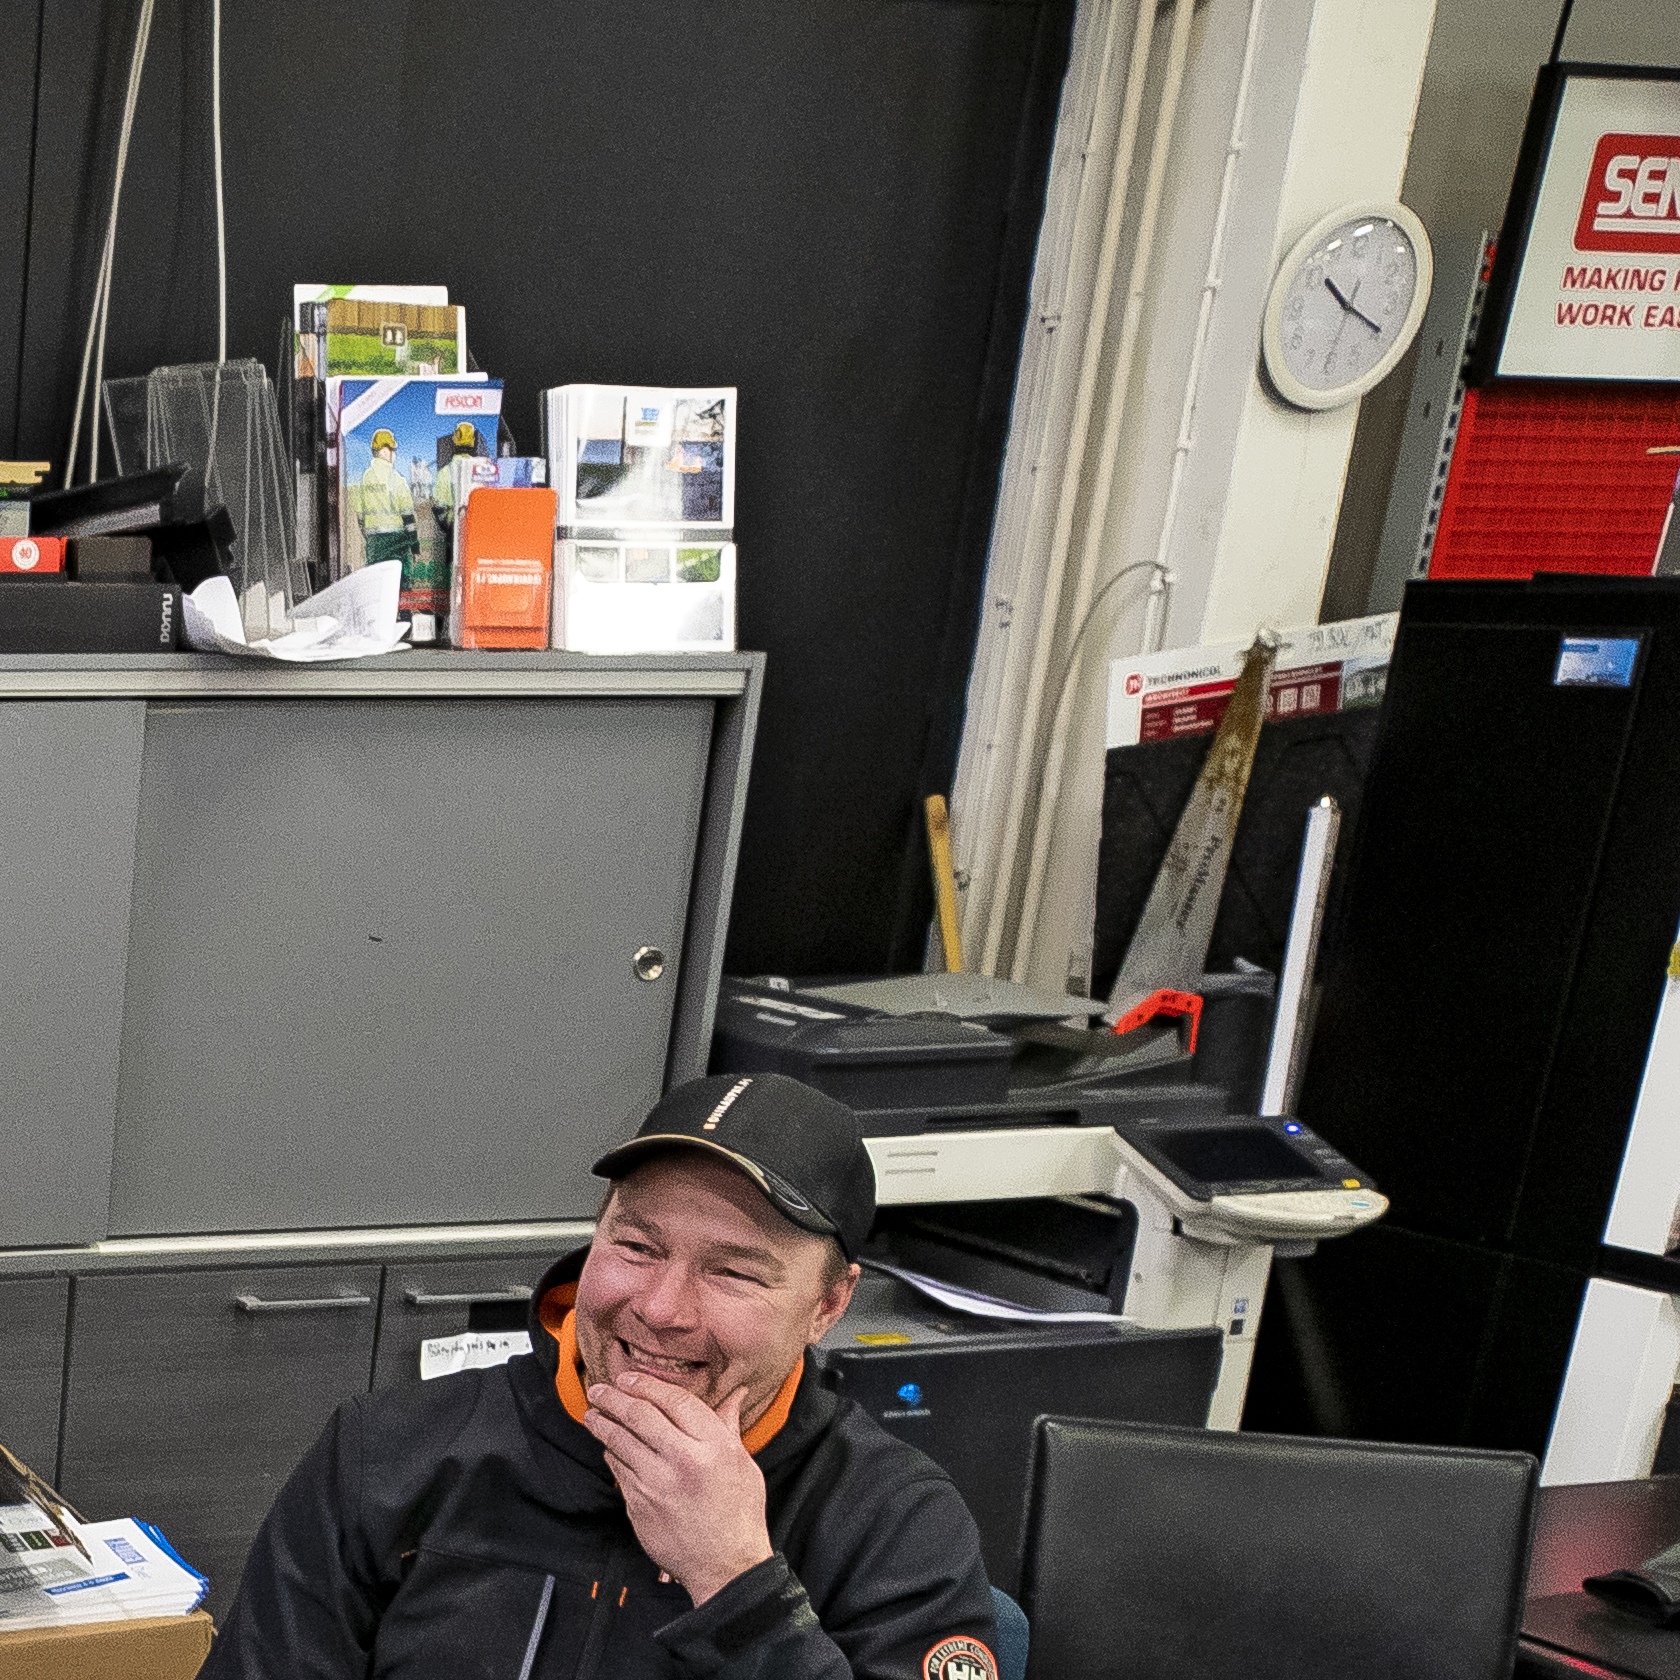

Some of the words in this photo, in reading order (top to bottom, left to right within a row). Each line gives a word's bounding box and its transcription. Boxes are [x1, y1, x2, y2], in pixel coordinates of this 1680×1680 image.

[1596, 154, 1680, 217] SEN
[1561, 265, 1667, 293] MAKING
[1555, 302, 1635, 328] WORK
